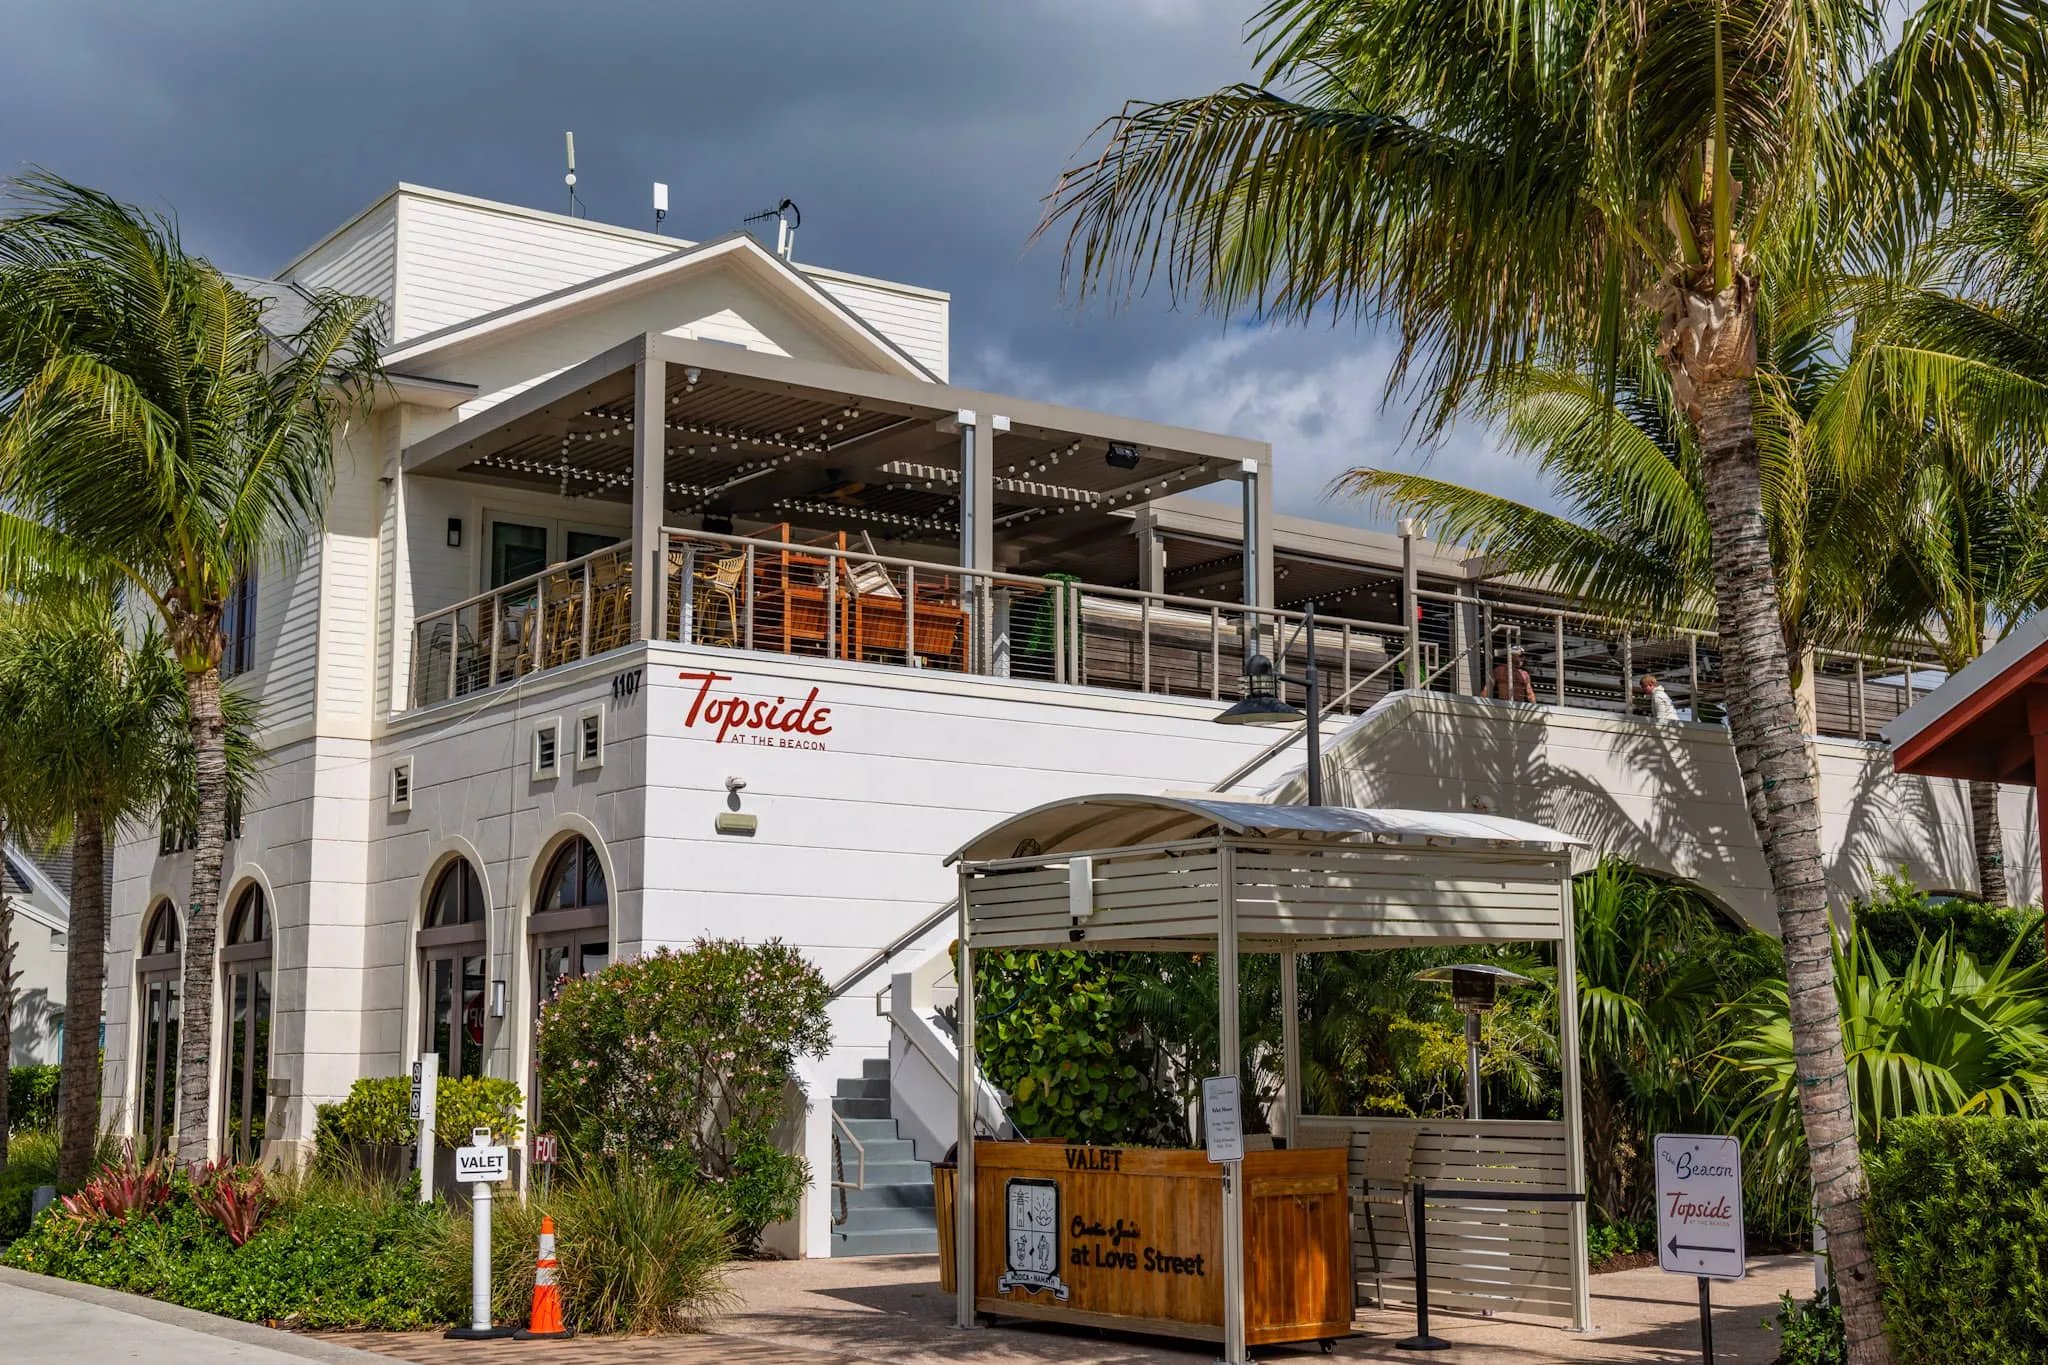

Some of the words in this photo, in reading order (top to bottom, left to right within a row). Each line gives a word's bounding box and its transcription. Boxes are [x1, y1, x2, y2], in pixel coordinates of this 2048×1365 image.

[612, 669, 642, 698] 1107
[678, 671, 832, 743] Topside
[731, 734, 745, 743] AT
[751, 736, 774, 746] THE
[779, 738, 826, 750] BEACON
[460, 1156, 504, 1168] VALET
[536, 1136, 556, 1161] FDC
[1064, 1148, 1122, 1171] VALET
[1676, 1152, 1733, 1180] Beacon
[1666, 1192, 1732, 1224] Topside
[1070, 1244, 1090, 1266] at
[1095, 1243, 1137, 1270] Love
[1143, 1246, 1205, 1277] Street
